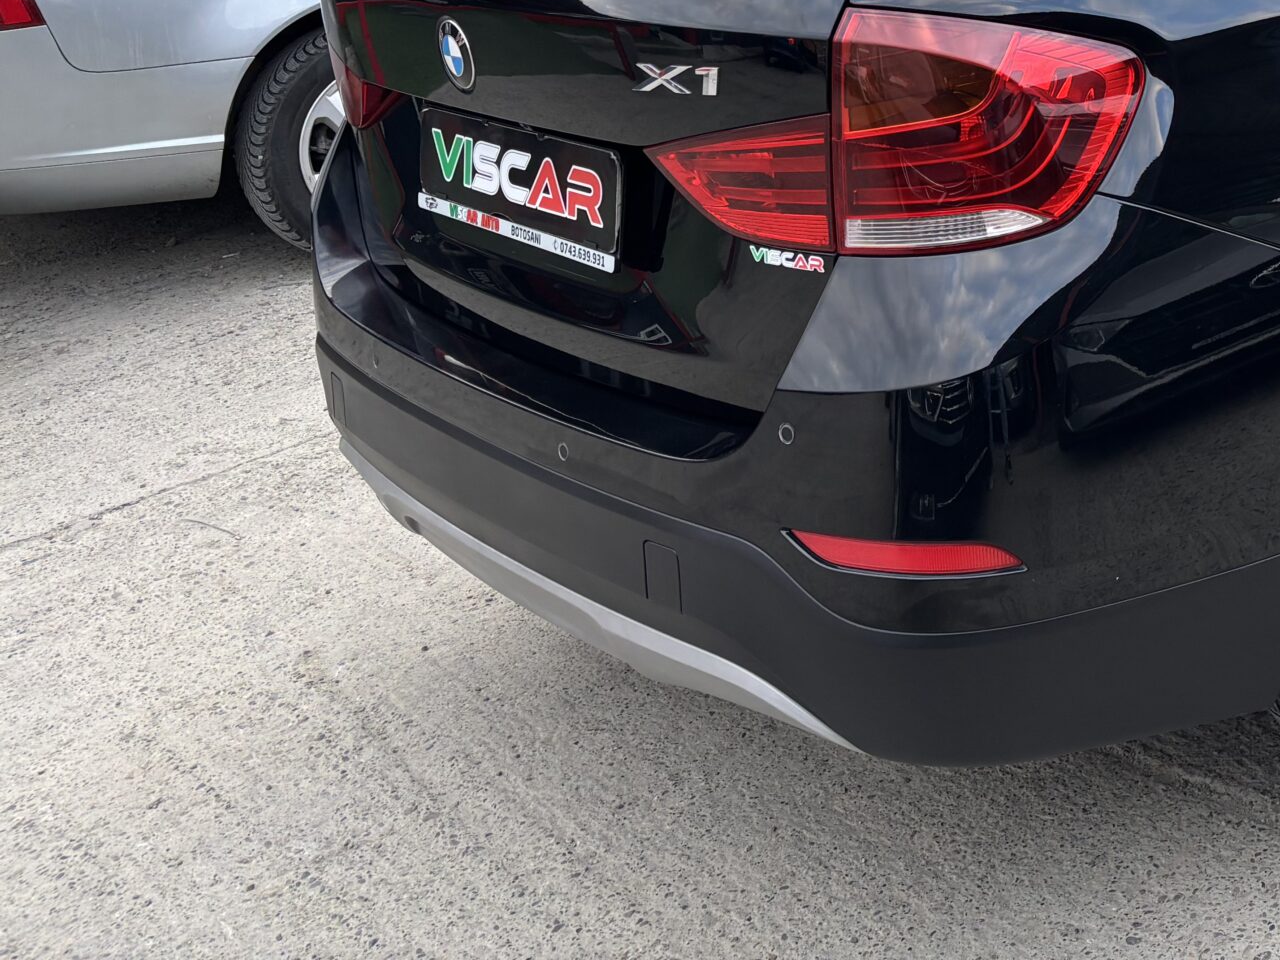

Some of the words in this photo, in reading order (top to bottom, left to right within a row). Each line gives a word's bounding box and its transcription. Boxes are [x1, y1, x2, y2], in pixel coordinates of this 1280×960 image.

[631, 62, 720, 96] X1
[431, 127, 604, 229] VISCAR
[449, 202, 479, 226] VISCAR
[481, 213, 500, 232] AUTO
[511, 224, 542, 246] BOTOSANI
[560, 241, 605, 268] 0743.639.931
[749, 245, 825, 273] VISCAR
